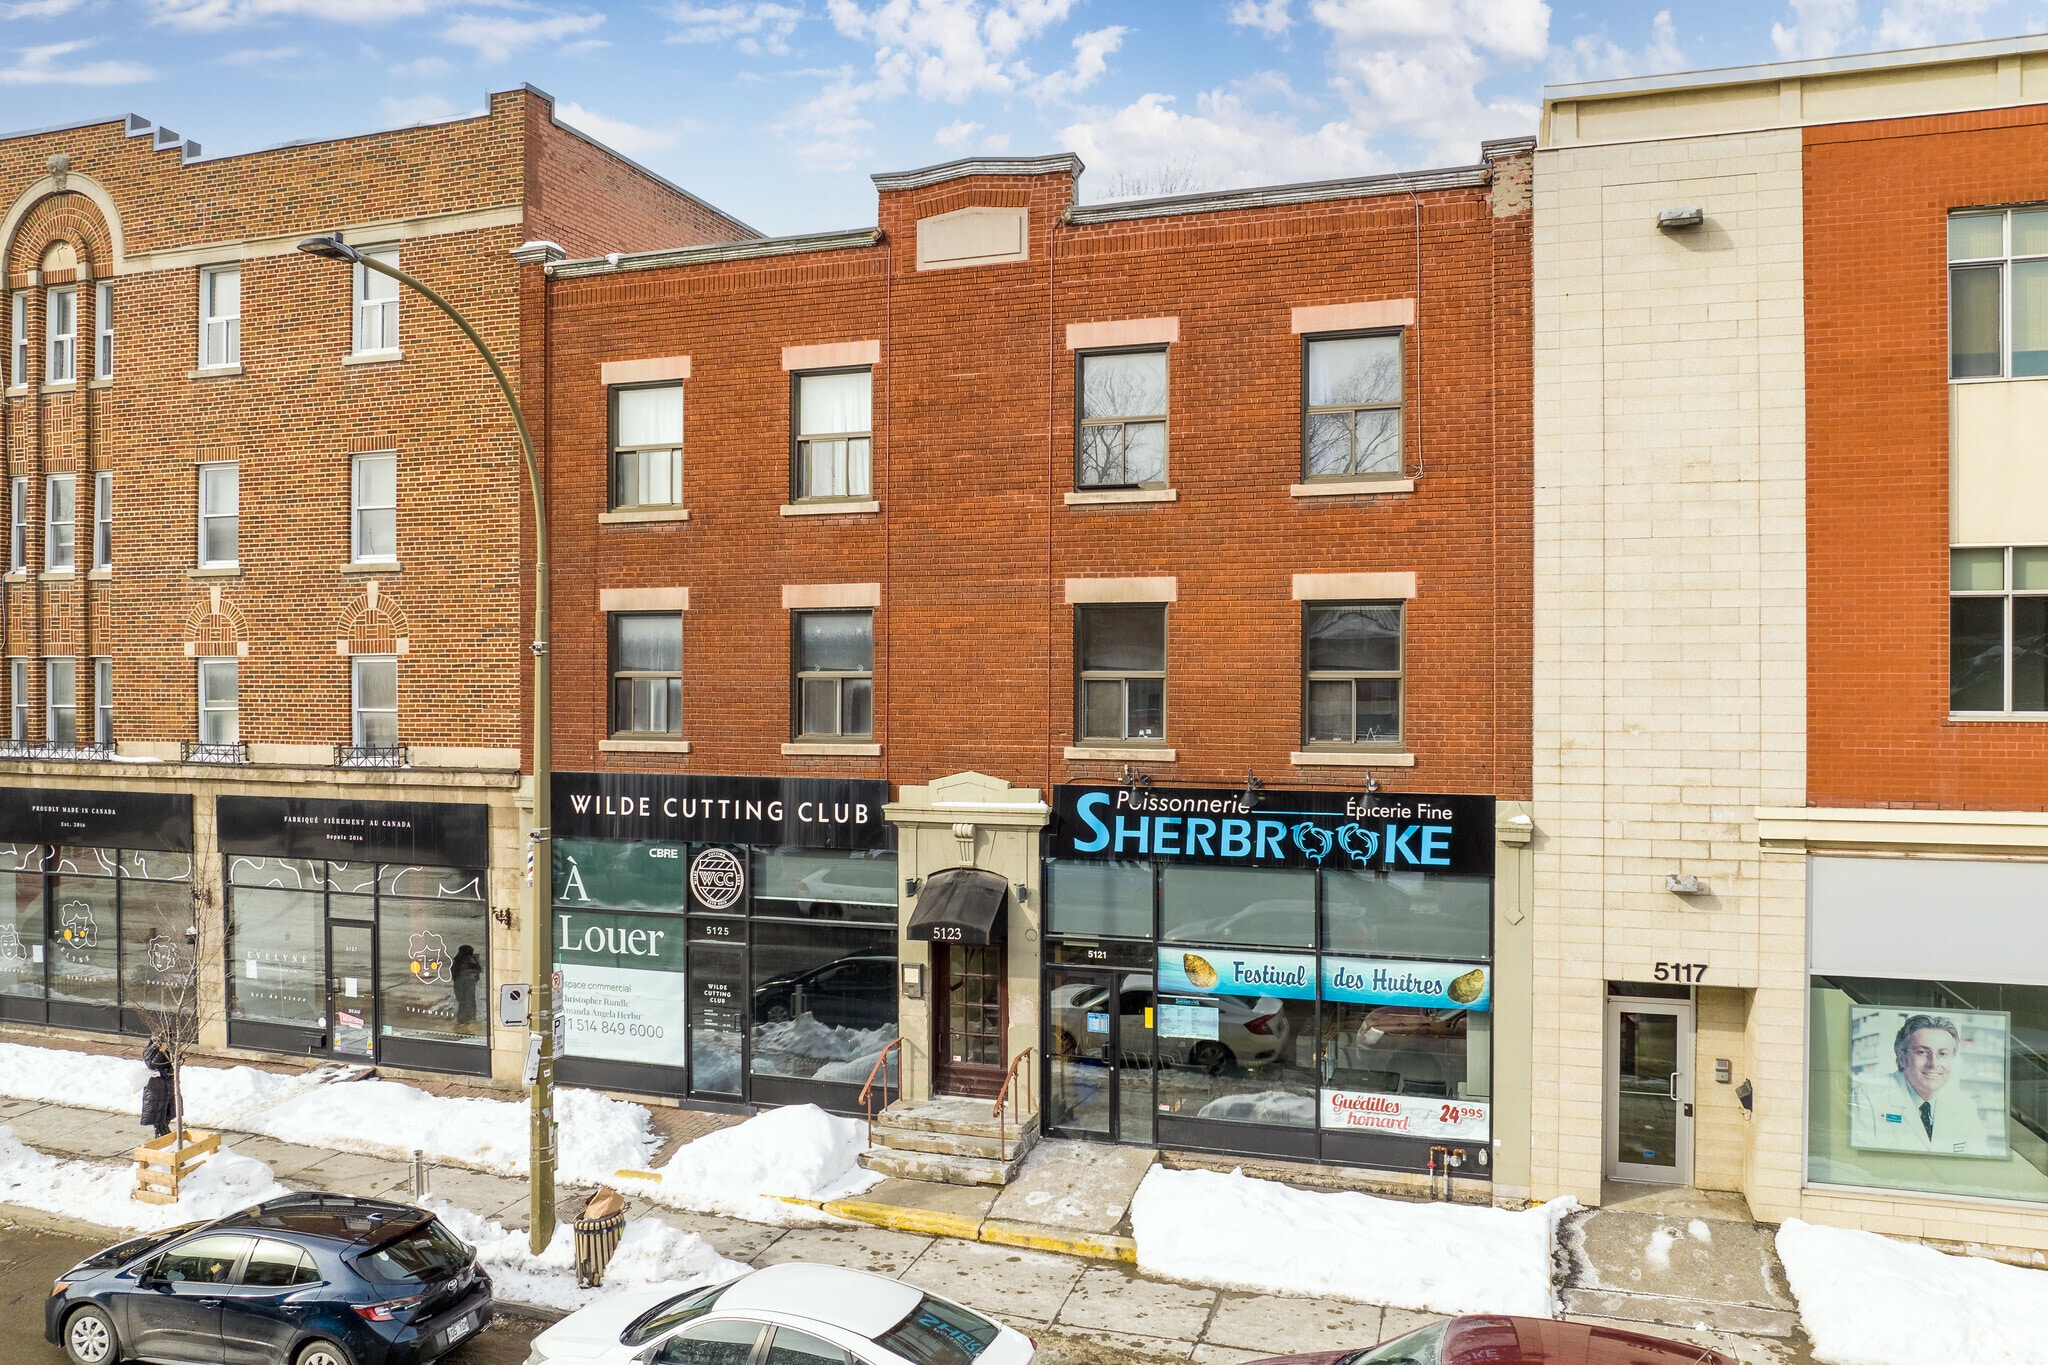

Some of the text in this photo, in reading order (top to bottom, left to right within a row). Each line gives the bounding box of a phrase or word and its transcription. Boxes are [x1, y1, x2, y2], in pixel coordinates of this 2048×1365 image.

[32, 805, 60, 813] PROUDLY
[62, 806, 80, 814] MADE
[570, 794, 869, 824] WILDE CUTTING CLUB
[1346, 796, 1453, 820] Épicerie Fine
[283, 815, 319, 825] FABRIQUÉ
[382, 820, 411, 828] CANADA
[1073, 791, 1453, 867] SHERBROOKE
[648, 848, 679, 859] CBRE
[559, 855, 591, 901] À
[699, 871, 734, 887] WCC
[558, 915, 665, 957] Louer
[706, 926, 730, 936] 5125
[933, 927, 962, 940] 5123
[247, 951, 308, 964] EVELYNE
[1087, 950, 1107, 959] 5121
[1233, 961, 1444, 995] Festival des Huîtres
[1653, 961, 1708, 983] 5117
[564, 981, 632, 993] space commercial
[703, 990, 732, 998] CUTTING
[564, 994, 603, 1006] hristopher
[576, 1018, 597, 1033] 514
[601, 1020, 626, 1036] 849
[629, 1023, 664, 1039] 6000
[1332, 1093, 1400, 1114] Guédilles
[1347, 1112, 1409, 1131] homard
